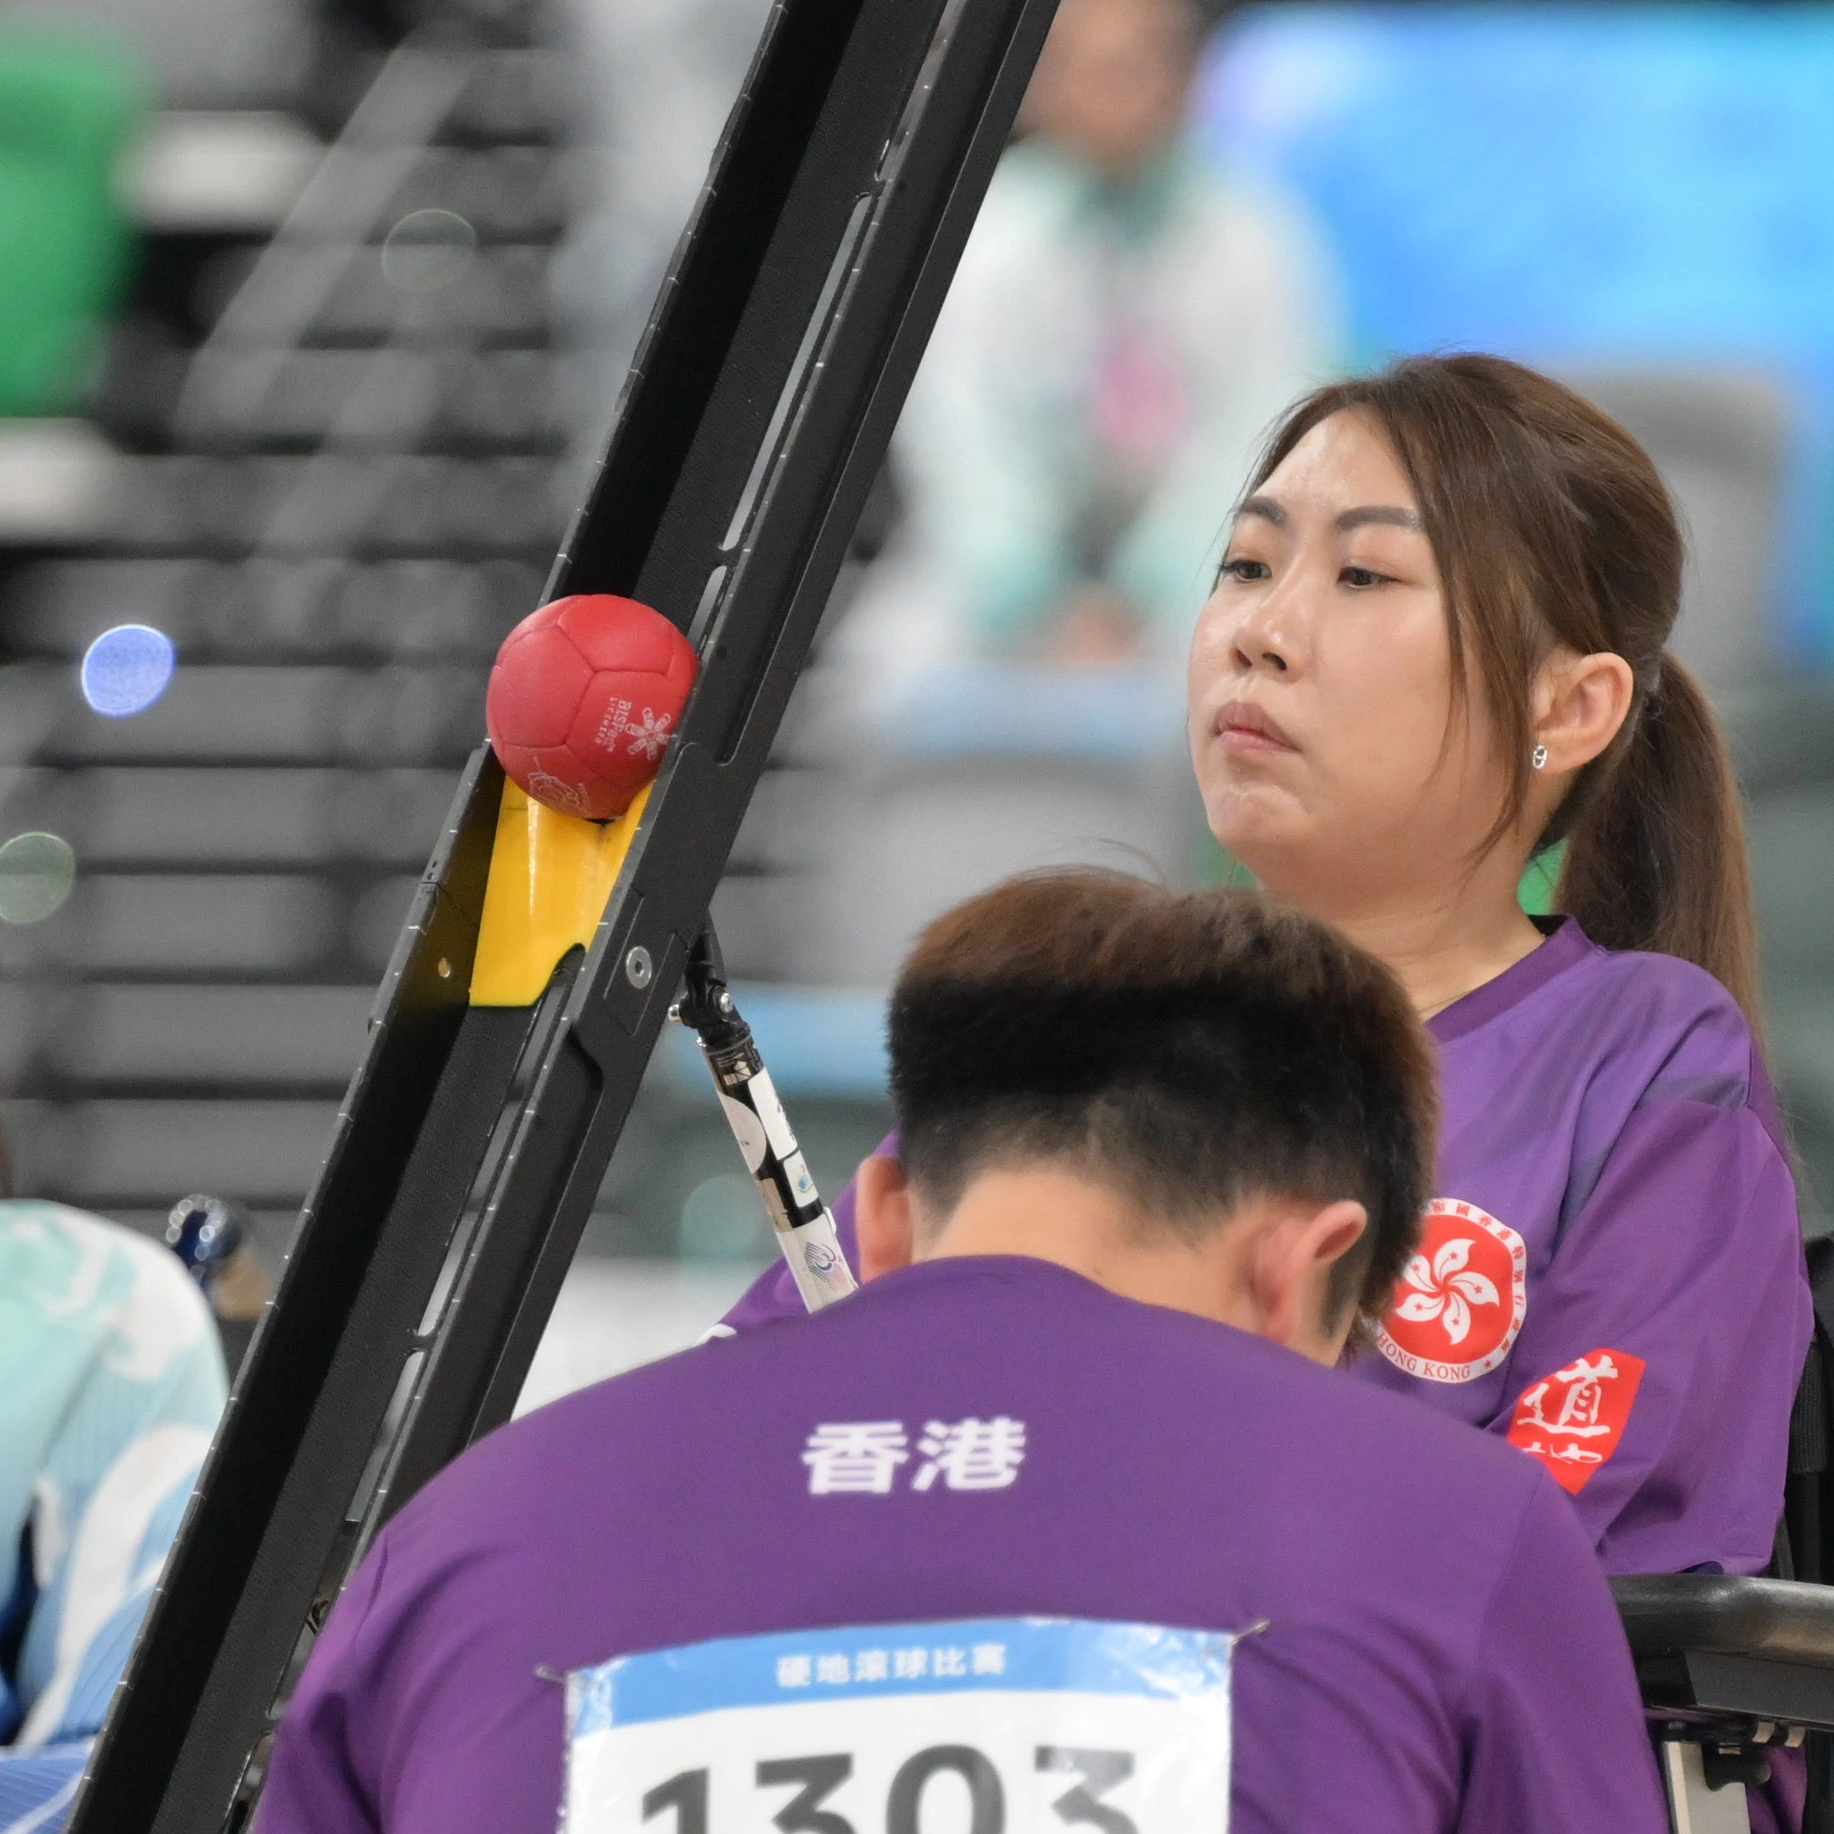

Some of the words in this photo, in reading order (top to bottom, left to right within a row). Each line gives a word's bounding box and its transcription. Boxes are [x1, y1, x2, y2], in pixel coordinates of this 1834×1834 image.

[1377, 1331, 1418, 1372] HONG
[1423, 1362, 1471, 1380] KONG
[800, 1415, 1027, 1495] 香港
